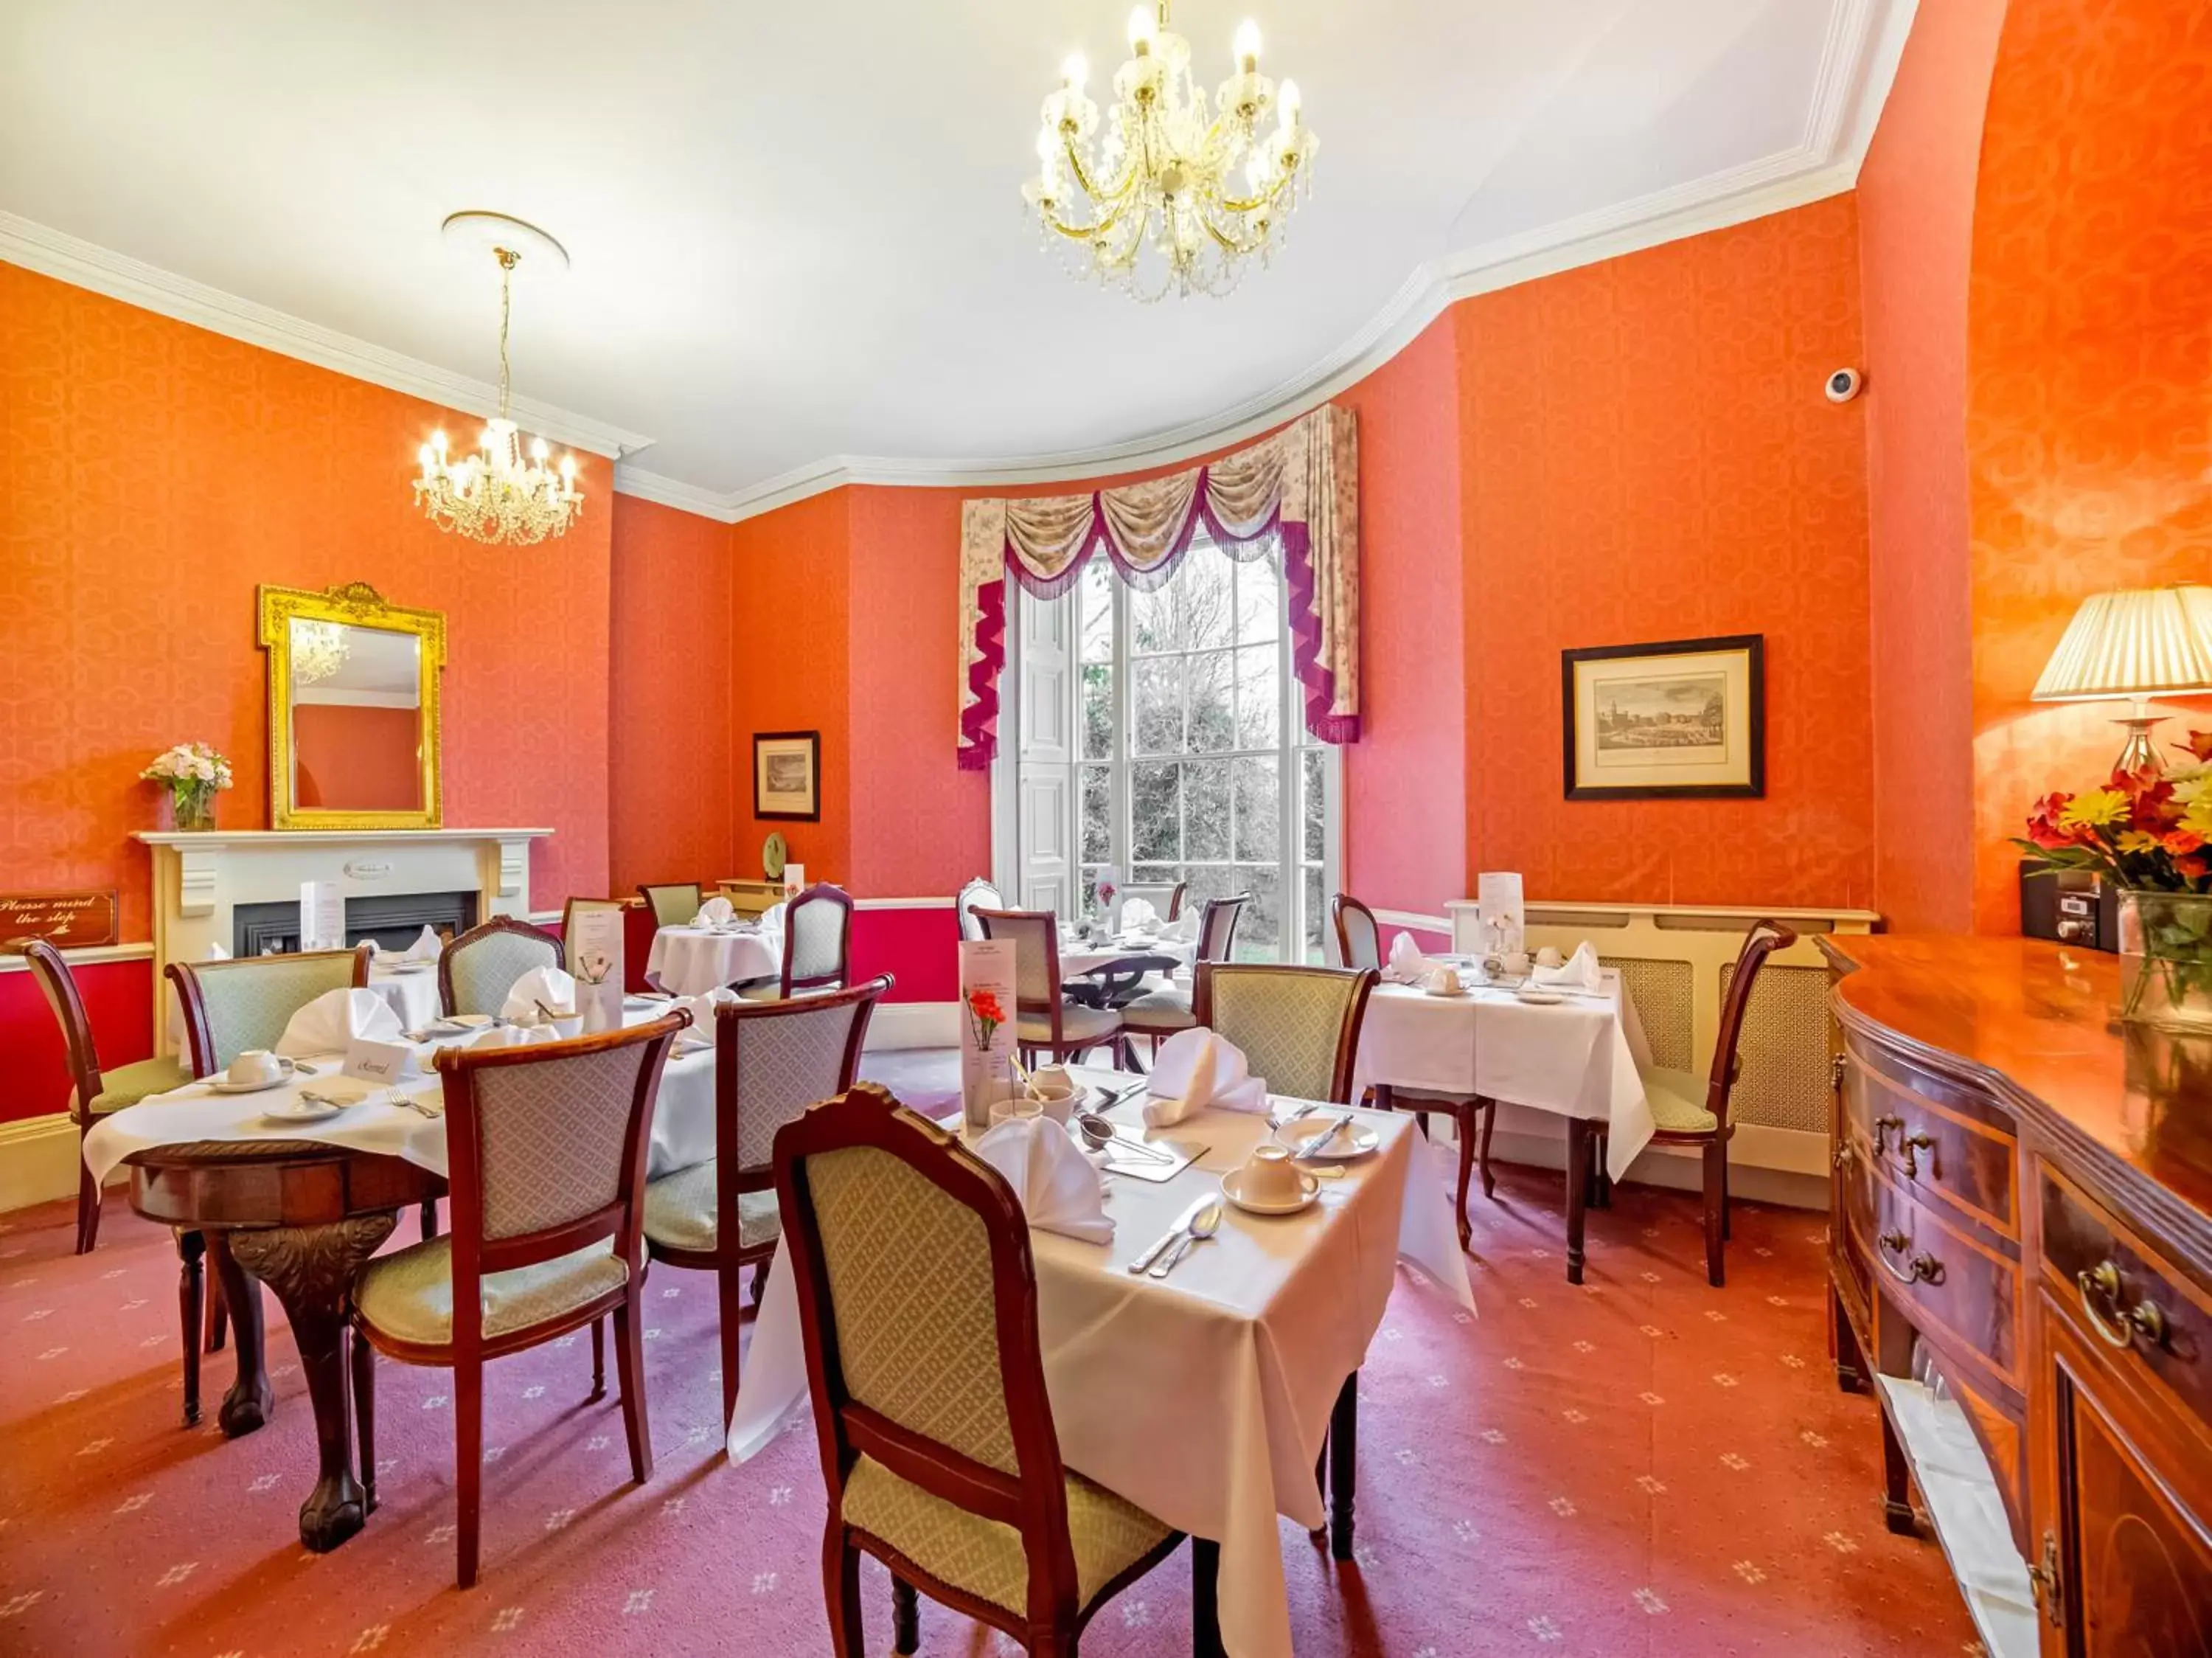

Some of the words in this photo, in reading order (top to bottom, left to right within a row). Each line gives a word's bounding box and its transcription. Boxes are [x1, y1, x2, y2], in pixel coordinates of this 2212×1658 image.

[0, 899, 46, 911] Please
[52, 896, 95, 909] mind
[15, 913, 41, 924] the
[47, 911, 77, 924] step
